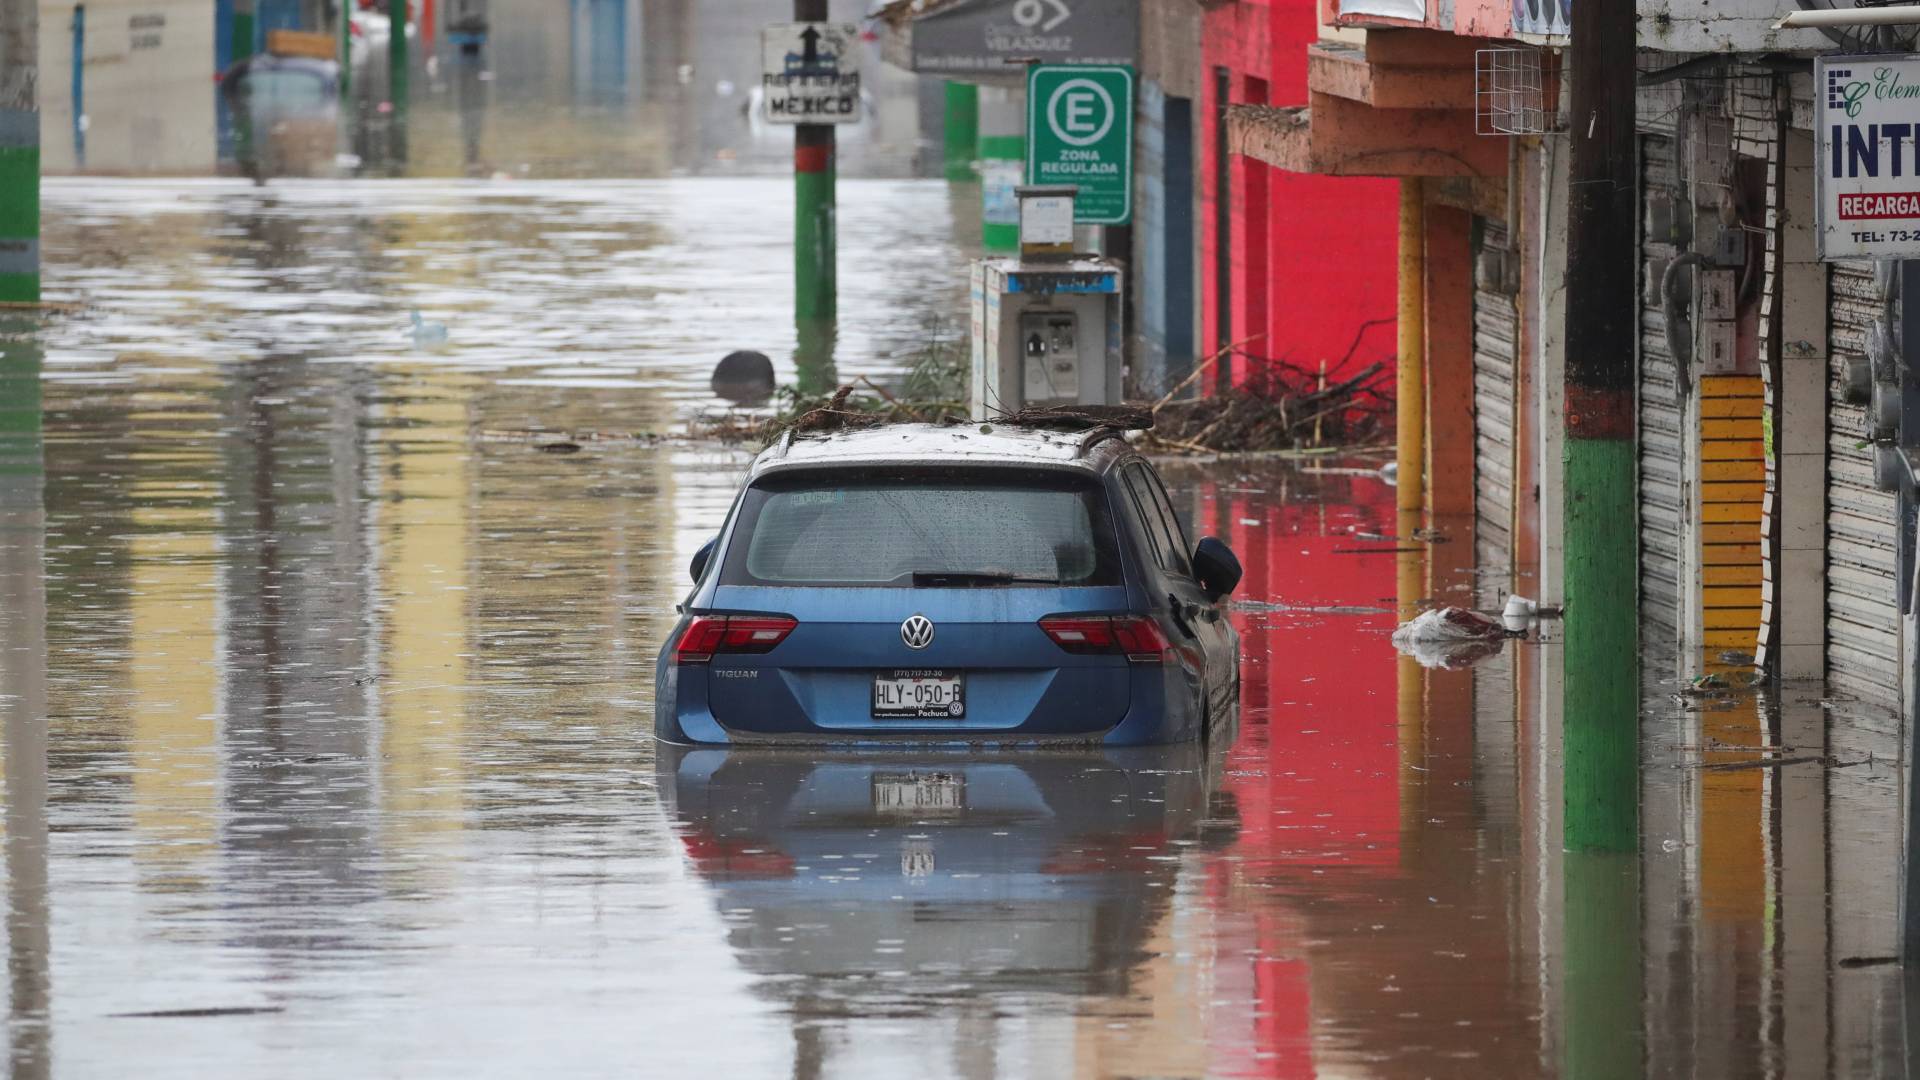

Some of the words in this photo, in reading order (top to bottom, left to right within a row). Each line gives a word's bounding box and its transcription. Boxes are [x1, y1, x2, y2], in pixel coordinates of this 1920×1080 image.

[772, 97, 853, 115] MEXICO
[1066, 92, 1095, 131] E
[1059, 149, 1100, 161] ZONA
[1832, 123, 1920, 178] INT
[1041, 162, 1118, 174] REGULADA
[1851, 231, 1885, 243] TEL:
[715, 670, 758, 679] TIGUAN
[918, 709, 949, 717] Pachuca
